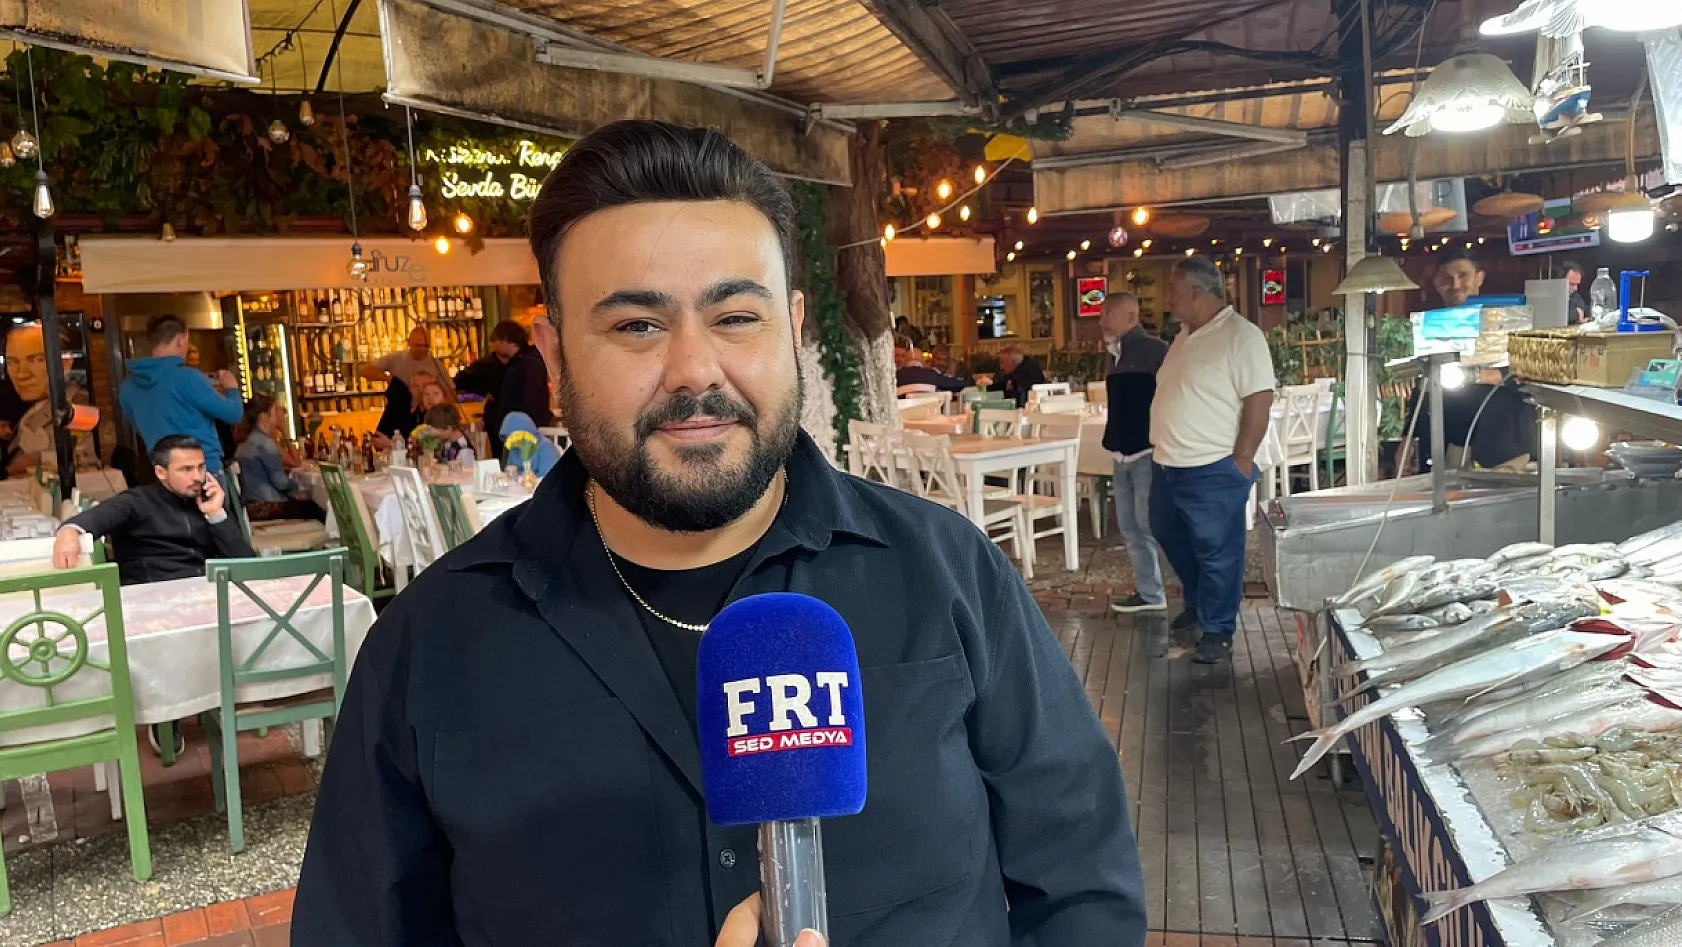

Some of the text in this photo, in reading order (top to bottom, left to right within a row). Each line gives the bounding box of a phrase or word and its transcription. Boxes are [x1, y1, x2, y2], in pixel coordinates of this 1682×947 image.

[442, 171, 504, 199] Sevda
[723, 671, 848, 737] FRT
[734, 730, 847, 755] SED MEDYA
